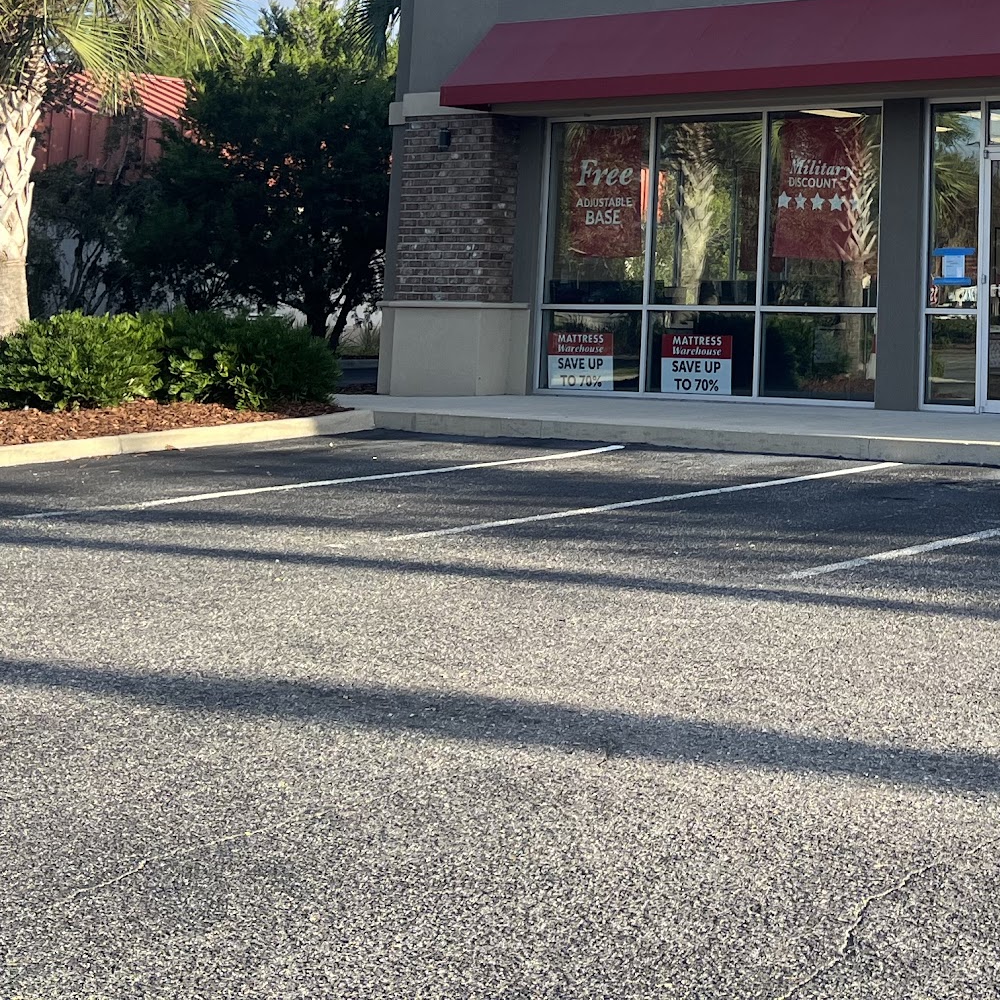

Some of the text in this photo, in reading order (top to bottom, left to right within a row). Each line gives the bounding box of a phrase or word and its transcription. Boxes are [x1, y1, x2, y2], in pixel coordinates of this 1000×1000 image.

[576, 158, 634, 188] Free
[789, 157, 853, 181] Military
[788, 176, 838, 189] DISCOUNT
[576, 196, 633, 209] ADJUSTABLE
[585, 208, 622, 226] BASE
[557, 334, 605, 344] MATTRESS
[672, 336, 722, 347] MATTRESS
[557, 344, 604, 354] Warehouse
[672, 346, 722, 356] Warehouse
[558, 358, 603, 370] SAVE UP
[672, 361, 721, 374] SAVE UP
[560, 375, 602, 388] TO 70%
[674, 379, 719, 392] TO 70%
